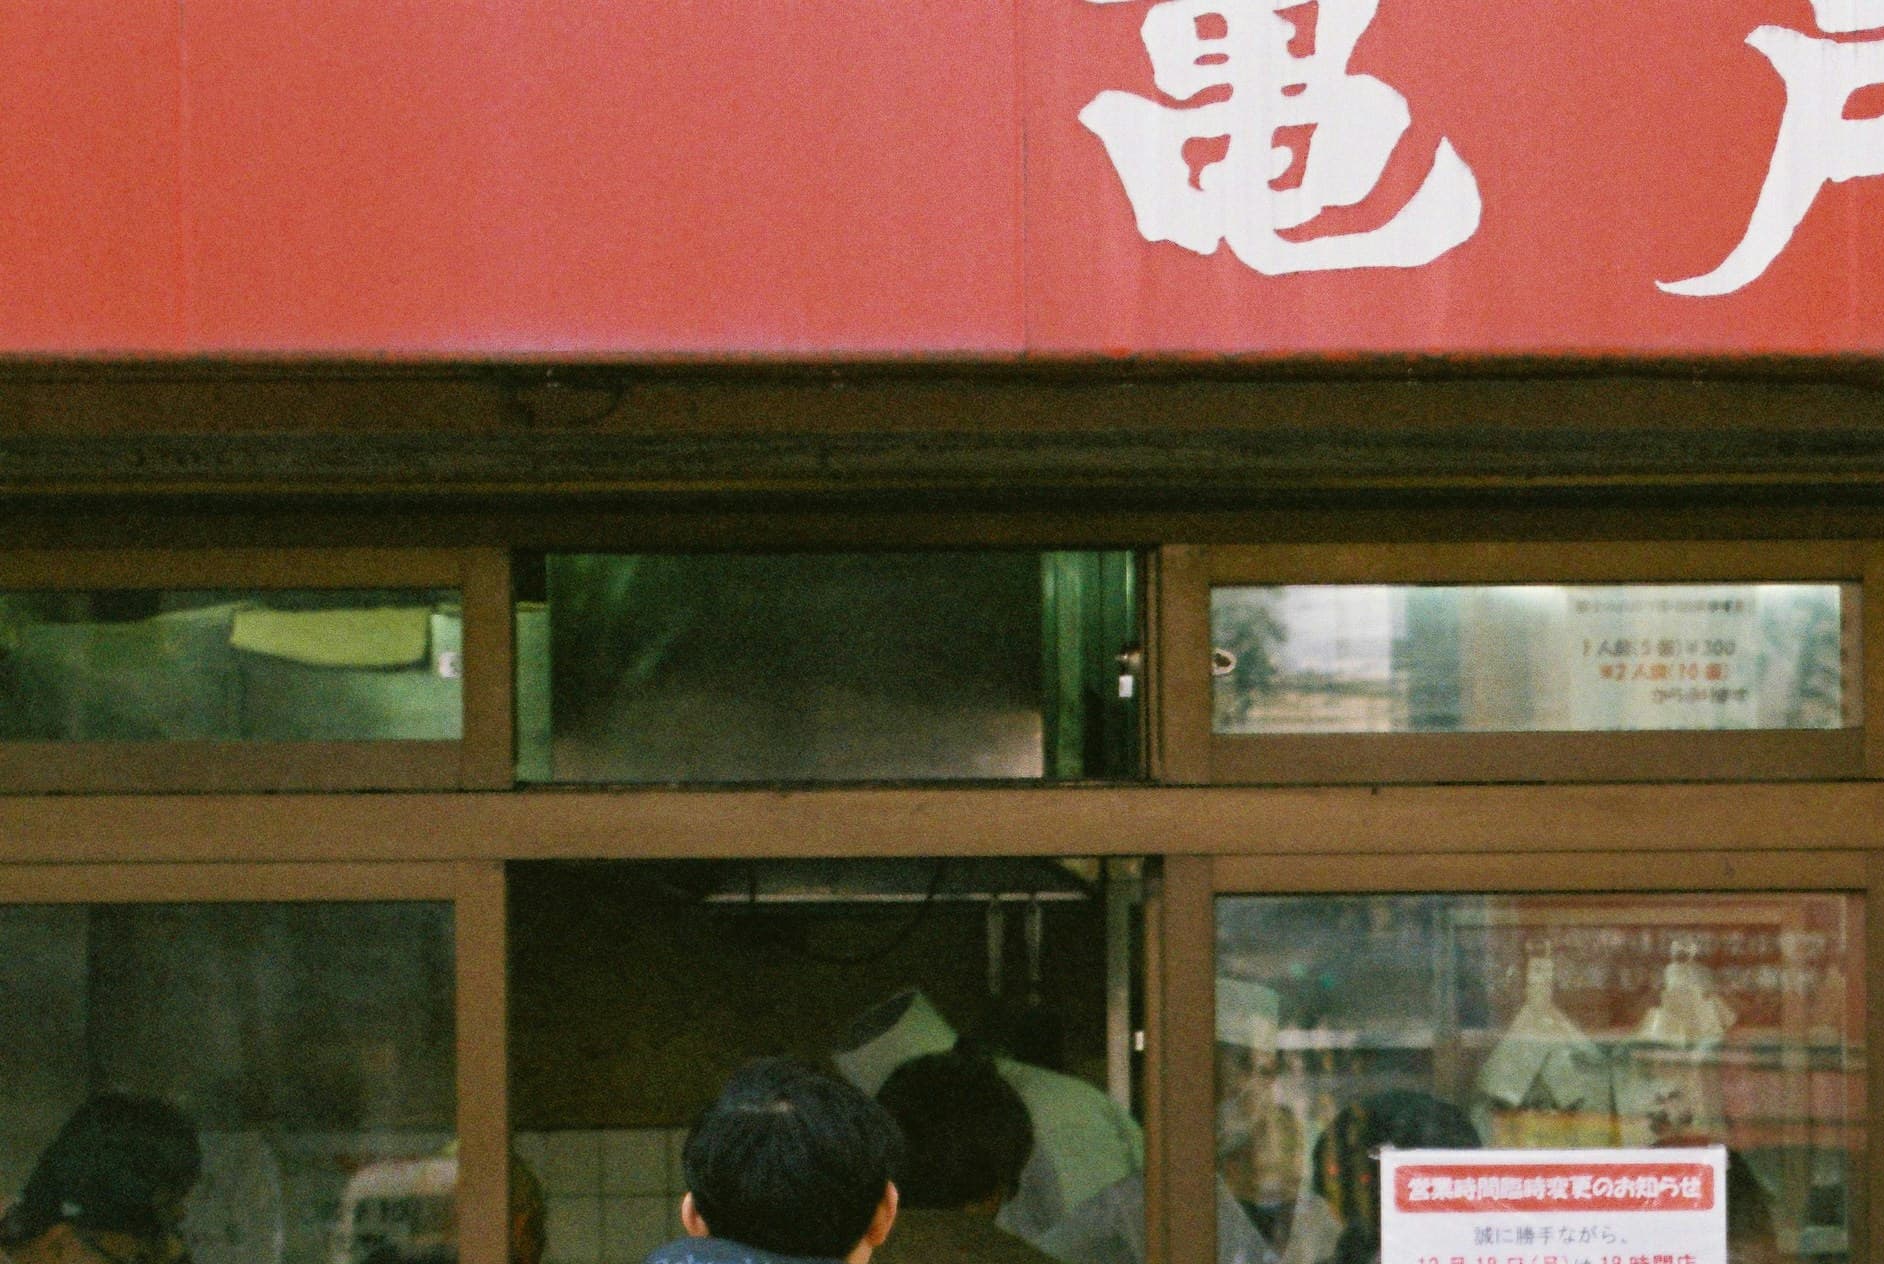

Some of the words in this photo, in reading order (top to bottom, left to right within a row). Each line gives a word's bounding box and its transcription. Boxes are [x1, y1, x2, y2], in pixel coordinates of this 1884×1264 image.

[1408, 1175, 1702, 1201] 営業時間臨時変更のお知らせ
[1474, 1226, 1630, 1246] 誠に勝手ながら、
